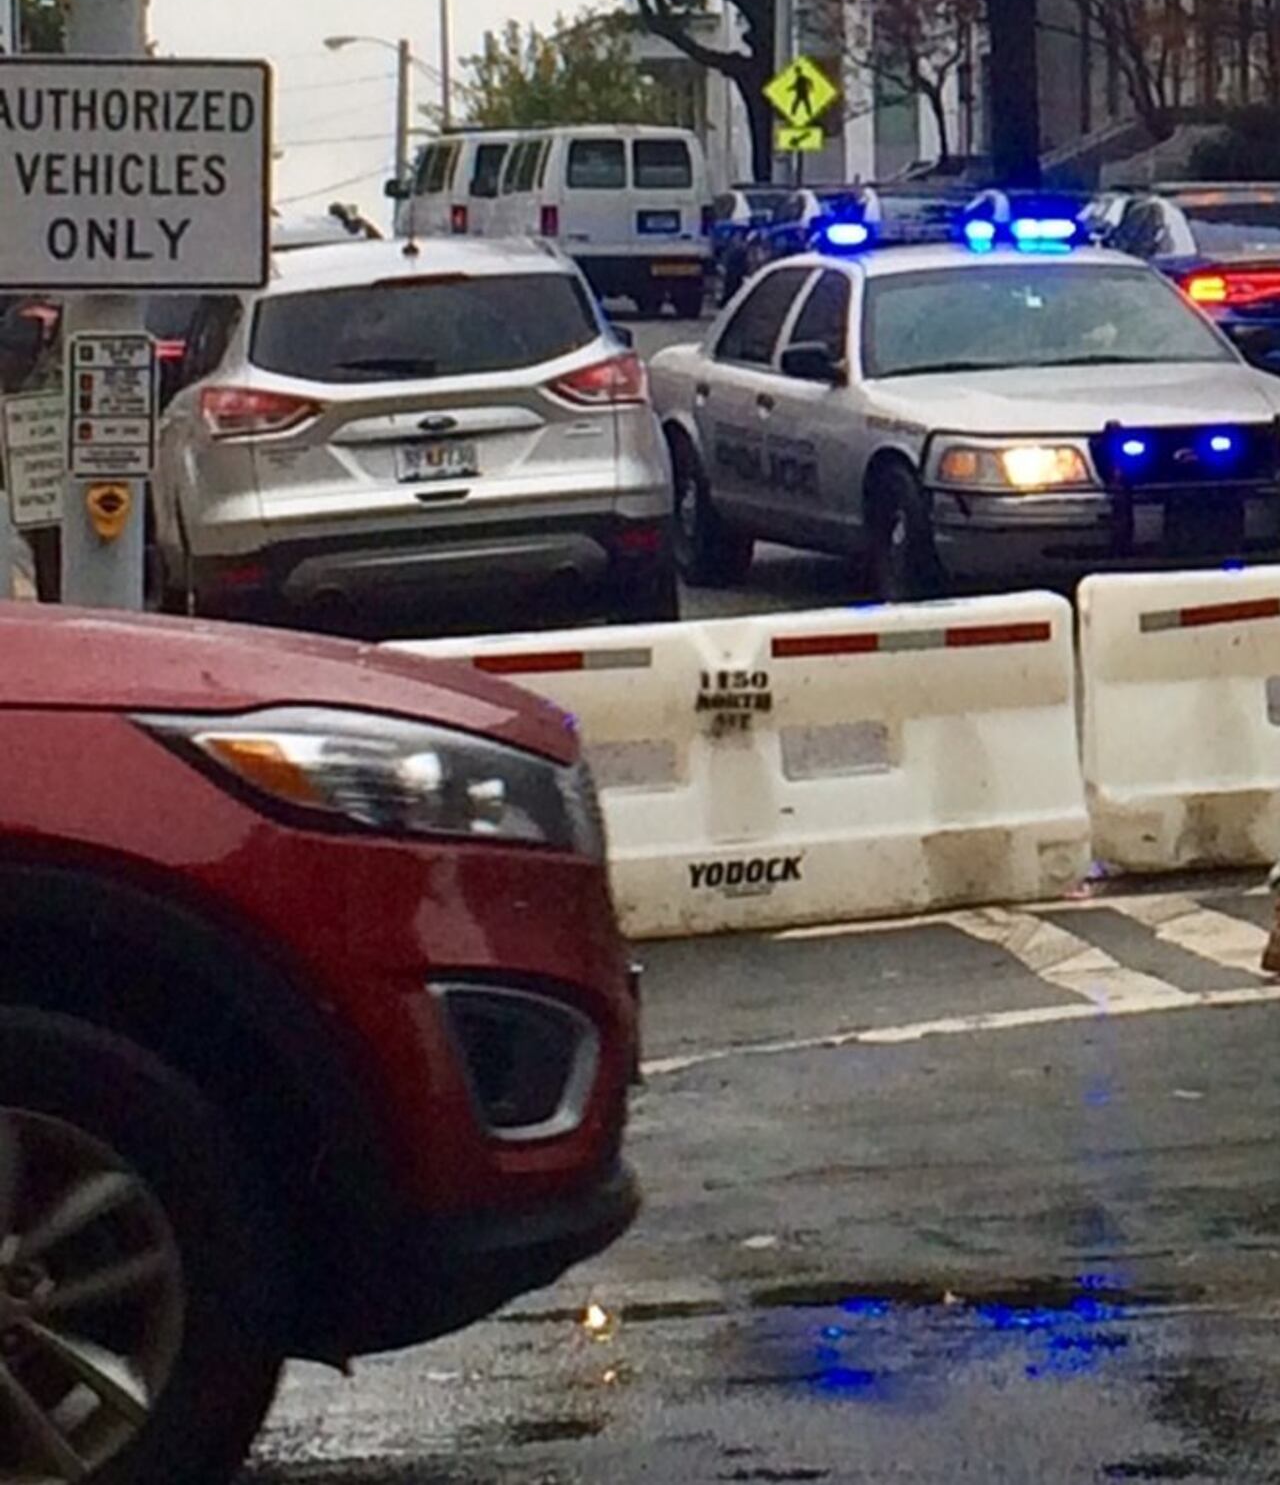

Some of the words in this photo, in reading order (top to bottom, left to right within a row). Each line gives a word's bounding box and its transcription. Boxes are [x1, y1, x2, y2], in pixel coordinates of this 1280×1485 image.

[15, 152, 227, 196] VEHICLES
[47, 217, 191, 260] ONLY
[689, 855, 803, 889] YODOCK
